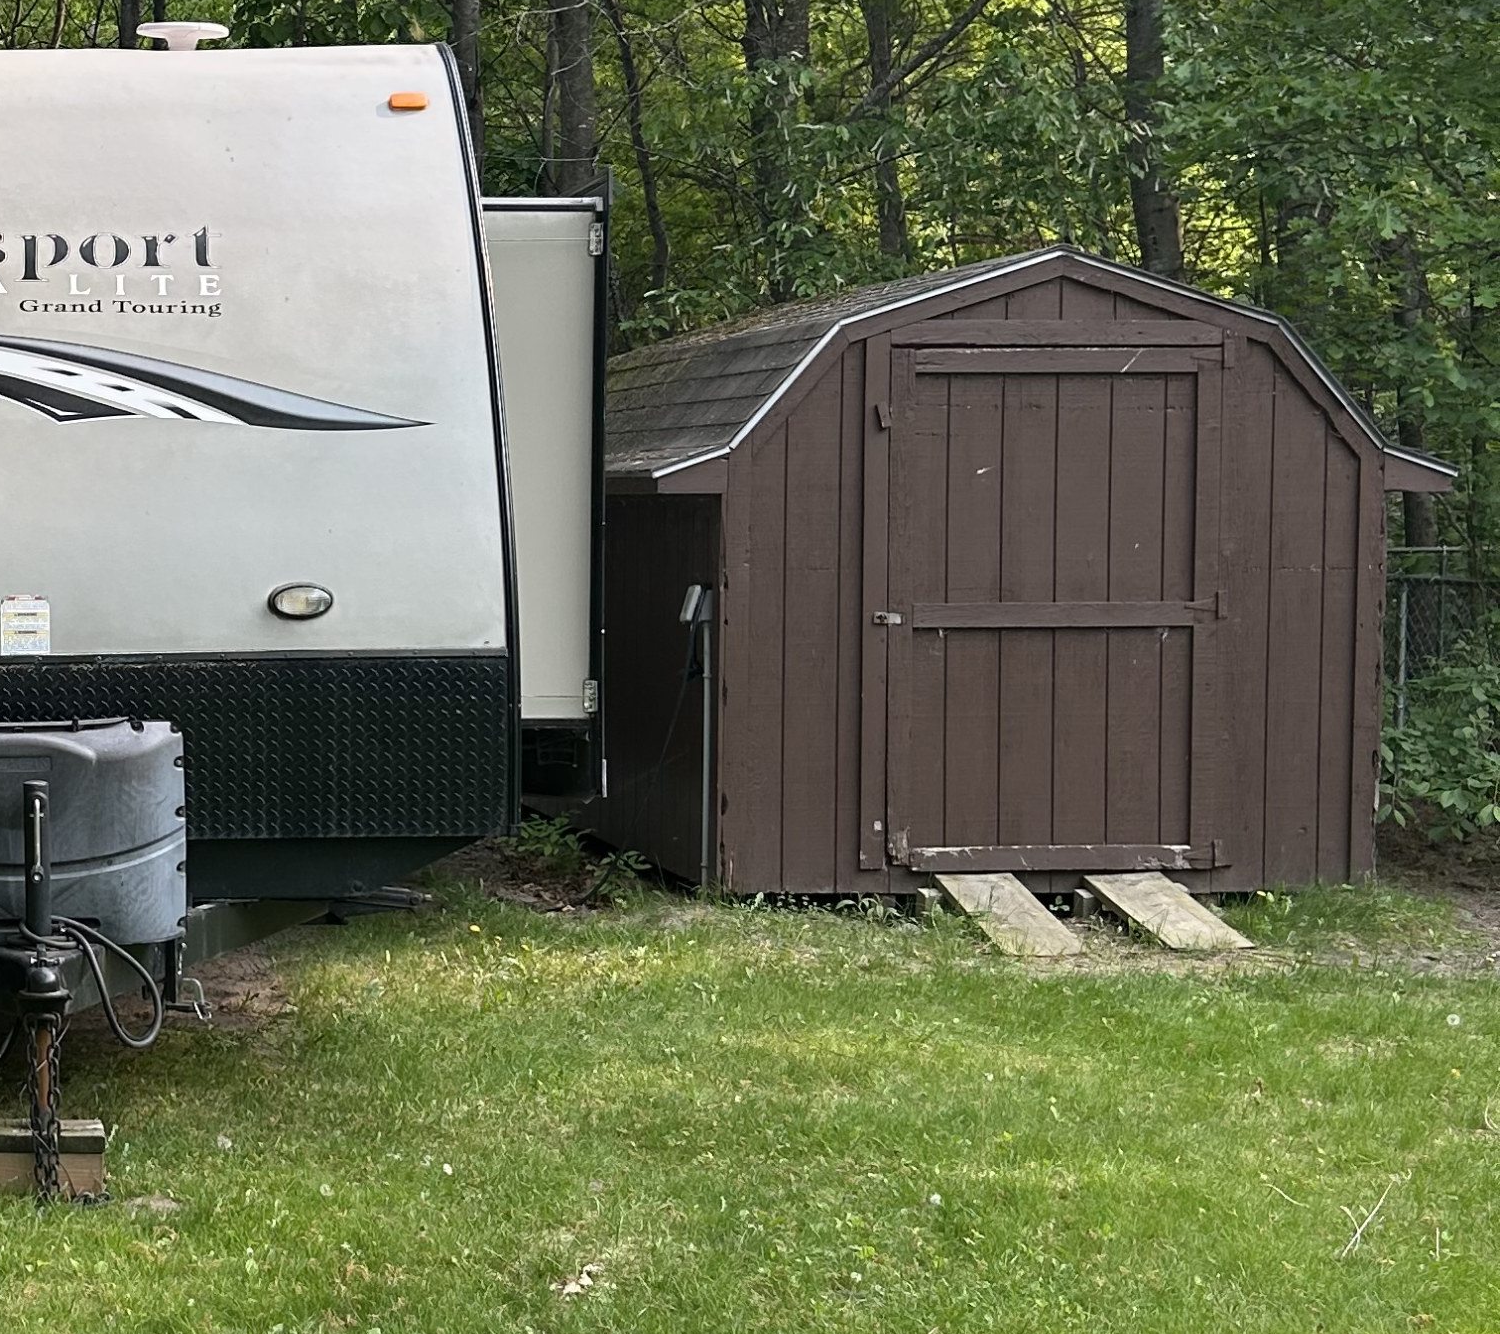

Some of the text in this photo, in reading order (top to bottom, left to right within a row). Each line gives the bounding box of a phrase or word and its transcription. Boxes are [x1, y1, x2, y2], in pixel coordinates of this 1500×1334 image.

[69, 274, 222, 296] LITE
[19, 299, 222, 317] Grand Touring
